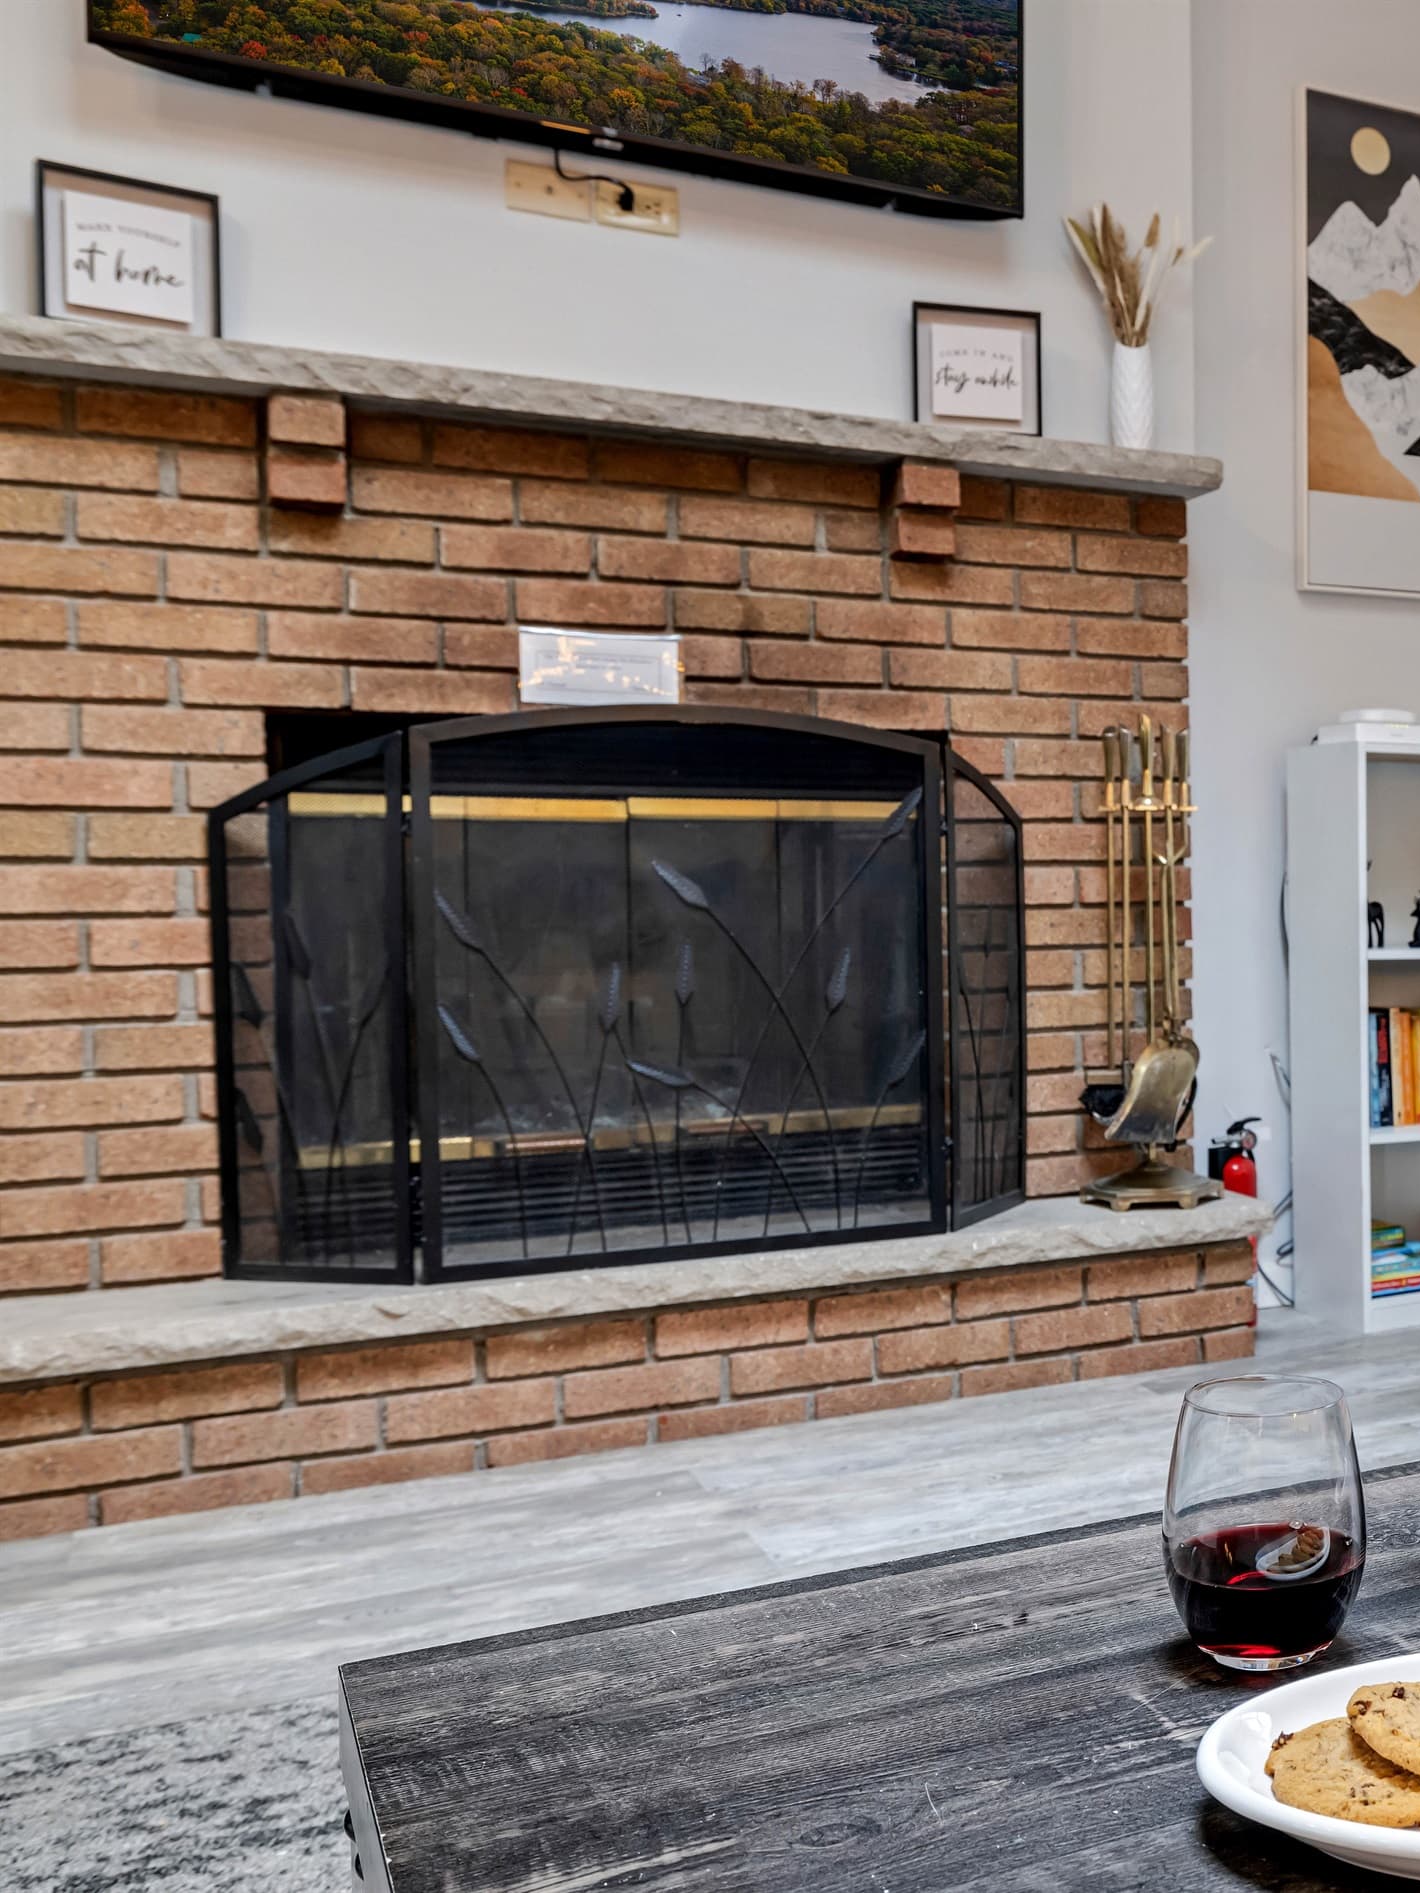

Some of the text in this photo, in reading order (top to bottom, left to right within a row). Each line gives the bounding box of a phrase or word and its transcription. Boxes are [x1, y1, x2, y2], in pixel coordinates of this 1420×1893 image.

[74, 241, 185, 288] at home
[935, 362, 970, 393] stay
